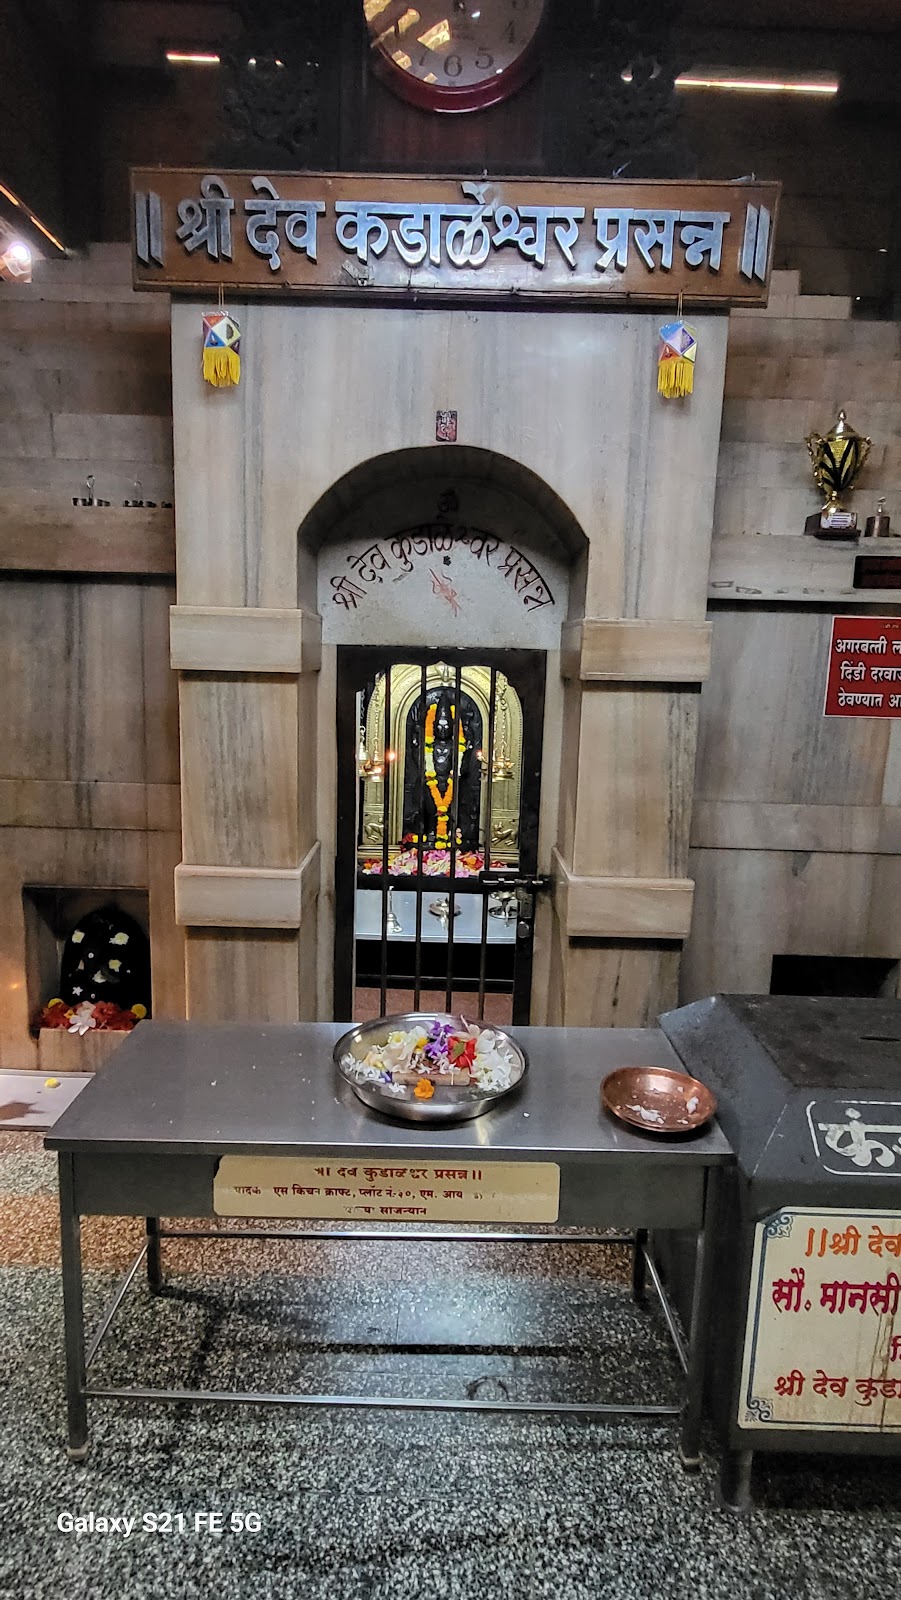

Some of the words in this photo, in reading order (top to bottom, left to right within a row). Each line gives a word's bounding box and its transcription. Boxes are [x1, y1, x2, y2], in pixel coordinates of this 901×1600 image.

[443, 54, 463, 77] 6
[475, 47, 494, 70] 5
[176, 174, 236, 262] श्री
[244, 175, 327, 273] देव
[593, 207, 731, 272] प्रसन्न
[346, 543, 391, 583] देव
[330, 575, 367, 610] श्री
[835, 635, 887, 655] अगरबत्ती
[840, 660, 866, 682] दिंडी
[837, 686, 883, 708] ठेवण्यात
[817, 1107, 901, 1168] फं
[433, 1169, 468, 1180] प्रसन्न
[273, 1186, 288, 1198] एस
[358, 1185, 383, 1197] प्लॉट
[771, 1267, 812, 1313] सौ.
[819, 1272, 901, 1316] मानसी
[773, 1369, 806, 1397] श्री
[812, 1369, 849, 1398] देव
